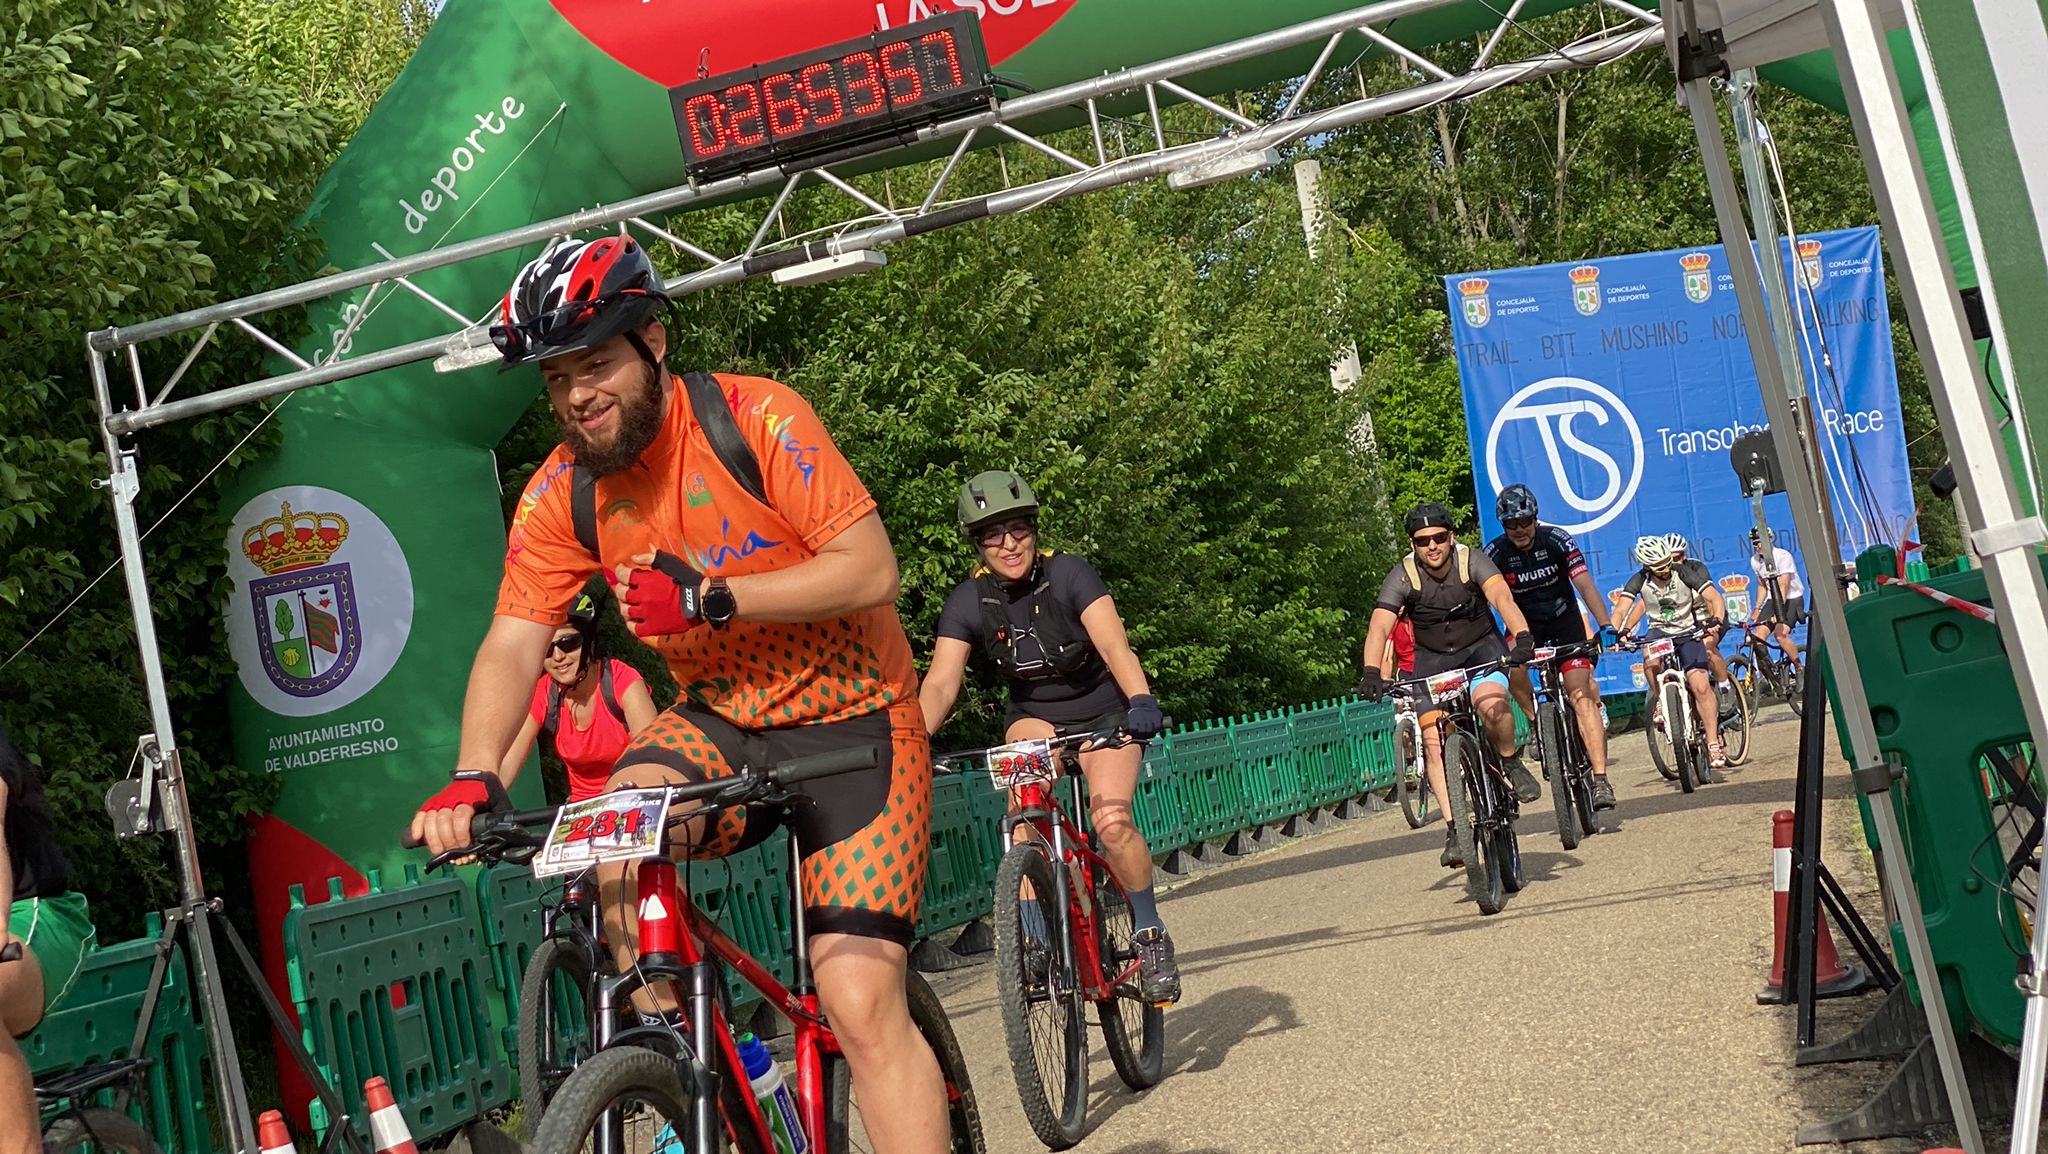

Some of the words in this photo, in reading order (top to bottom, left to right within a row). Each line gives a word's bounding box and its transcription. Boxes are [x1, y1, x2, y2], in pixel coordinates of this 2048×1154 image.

[399, 96, 525, 234] deporte
[1840, 266, 1873, 277] DEPORTES
[1607, 295, 1618, 304] DE
[1619, 292, 1650, 303] DEPORTES
[1718, 283, 1728, 291] DE
[1497, 308, 1507, 316] DE
[1507, 305, 1540, 315] DEPORTES
[1463, 339, 1520, 369] TRAIL
[1540, 332, 1577, 361] BTT
[1601, 319, 1690, 353] MUSHING
[1824, 408, 1884, 436] Race
[268, 717, 385, 752] AYUNTAMIENTO
[265, 757, 281, 774] DE
[283, 736, 400, 771] VALDEFRESNO
[638, 799, 662, 807] BIKE
[565, 807, 642, 842] 231
